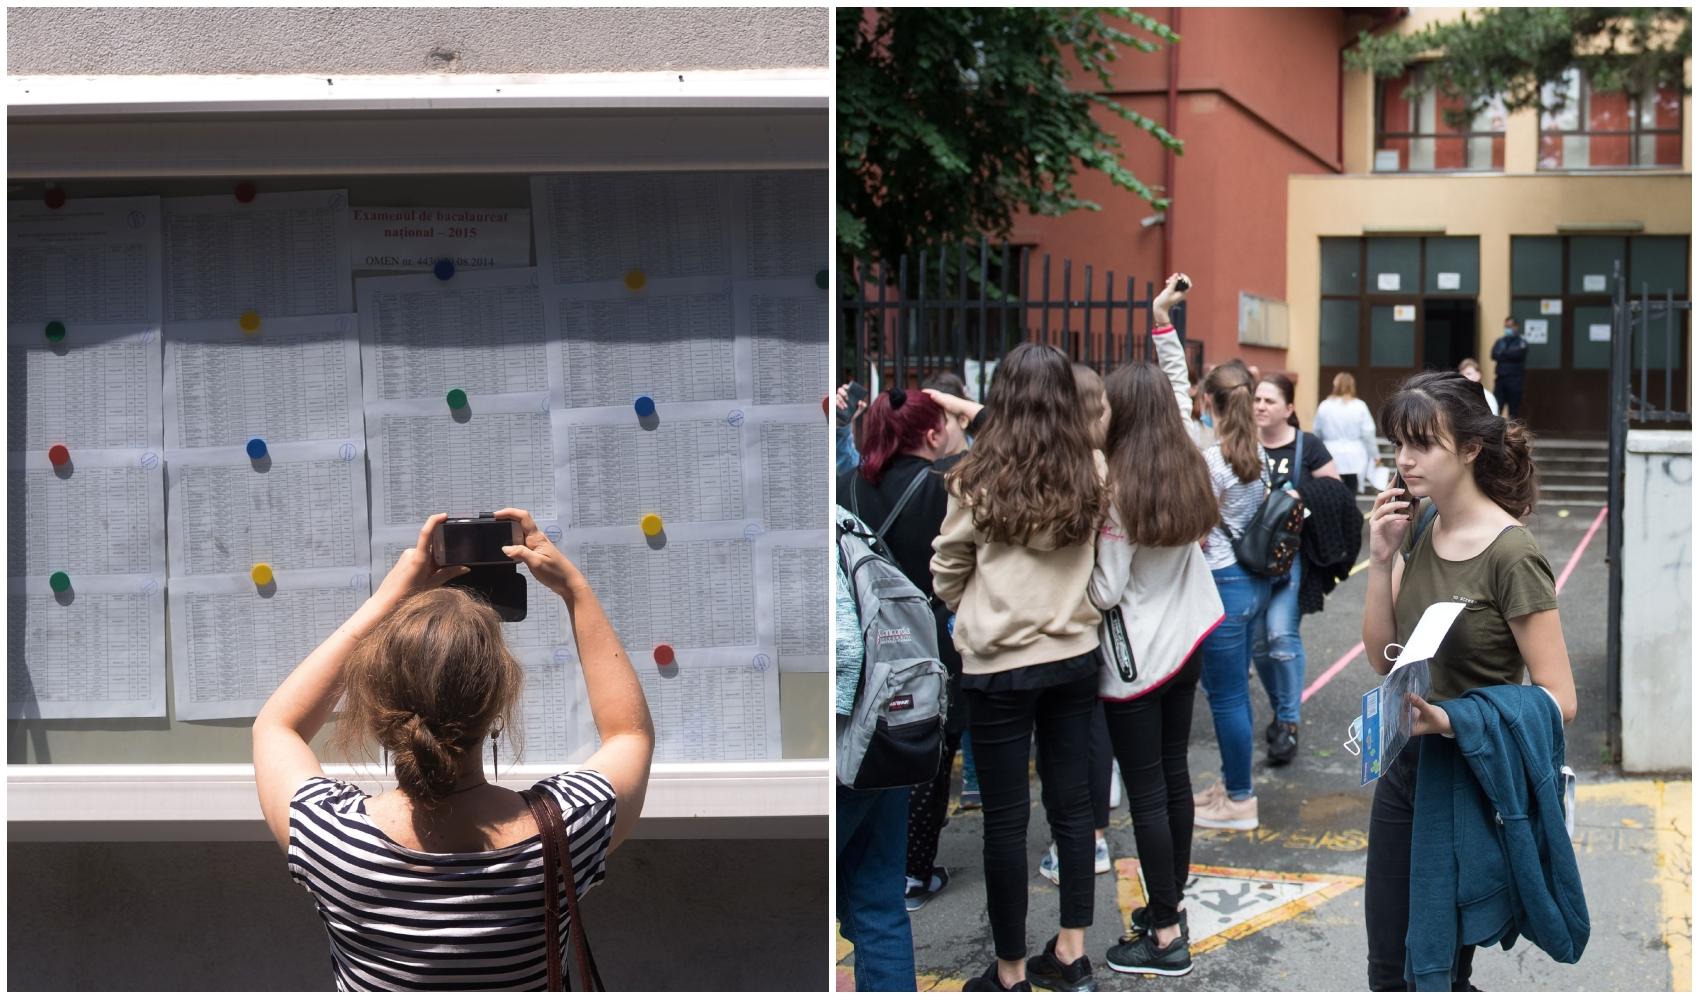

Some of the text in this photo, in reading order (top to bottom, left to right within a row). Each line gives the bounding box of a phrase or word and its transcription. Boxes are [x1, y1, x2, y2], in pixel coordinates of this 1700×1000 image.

[353, 209, 508, 223] Examenul de bacalaureat
[448, 226, 477, 238] 2015
[366, 256, 399, 266] OMEN
